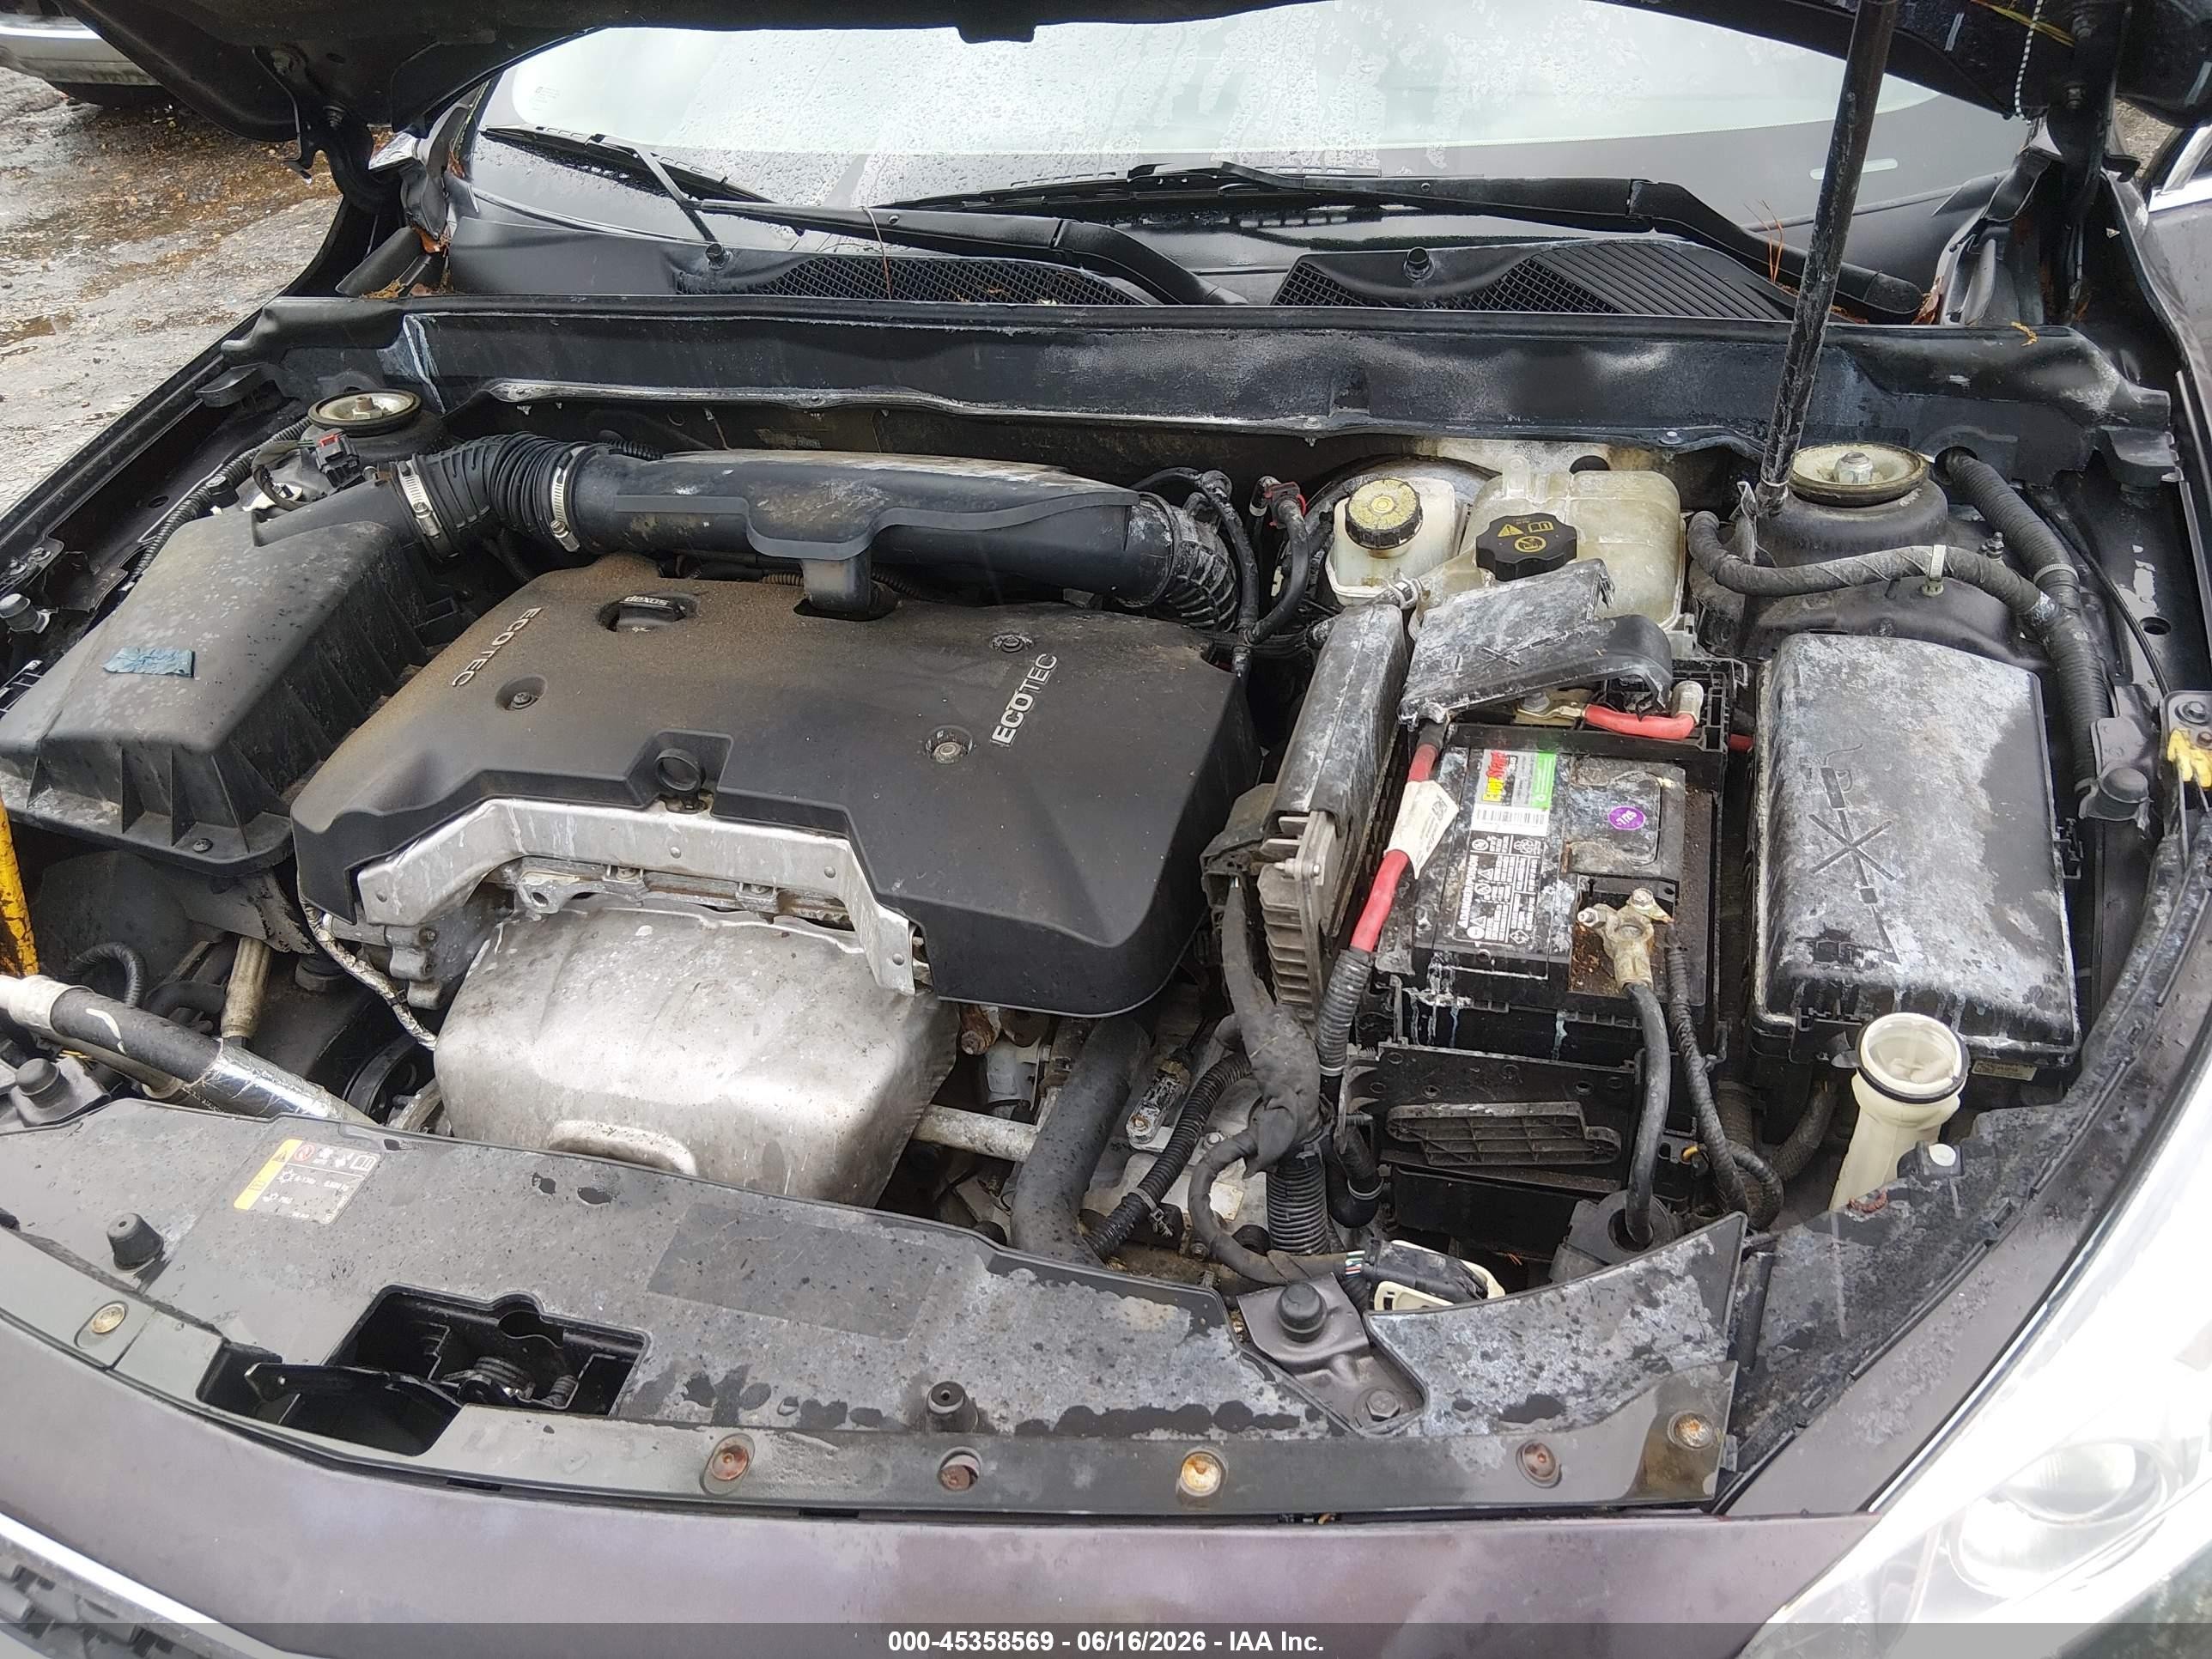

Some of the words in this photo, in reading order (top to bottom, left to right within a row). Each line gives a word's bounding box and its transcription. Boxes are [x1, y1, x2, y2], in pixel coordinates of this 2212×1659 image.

[624, 595, 668, 606] dexos
[453, 607, 542, 686] ECOTEC
[992, 653, 1057, 744] ECOTEC
